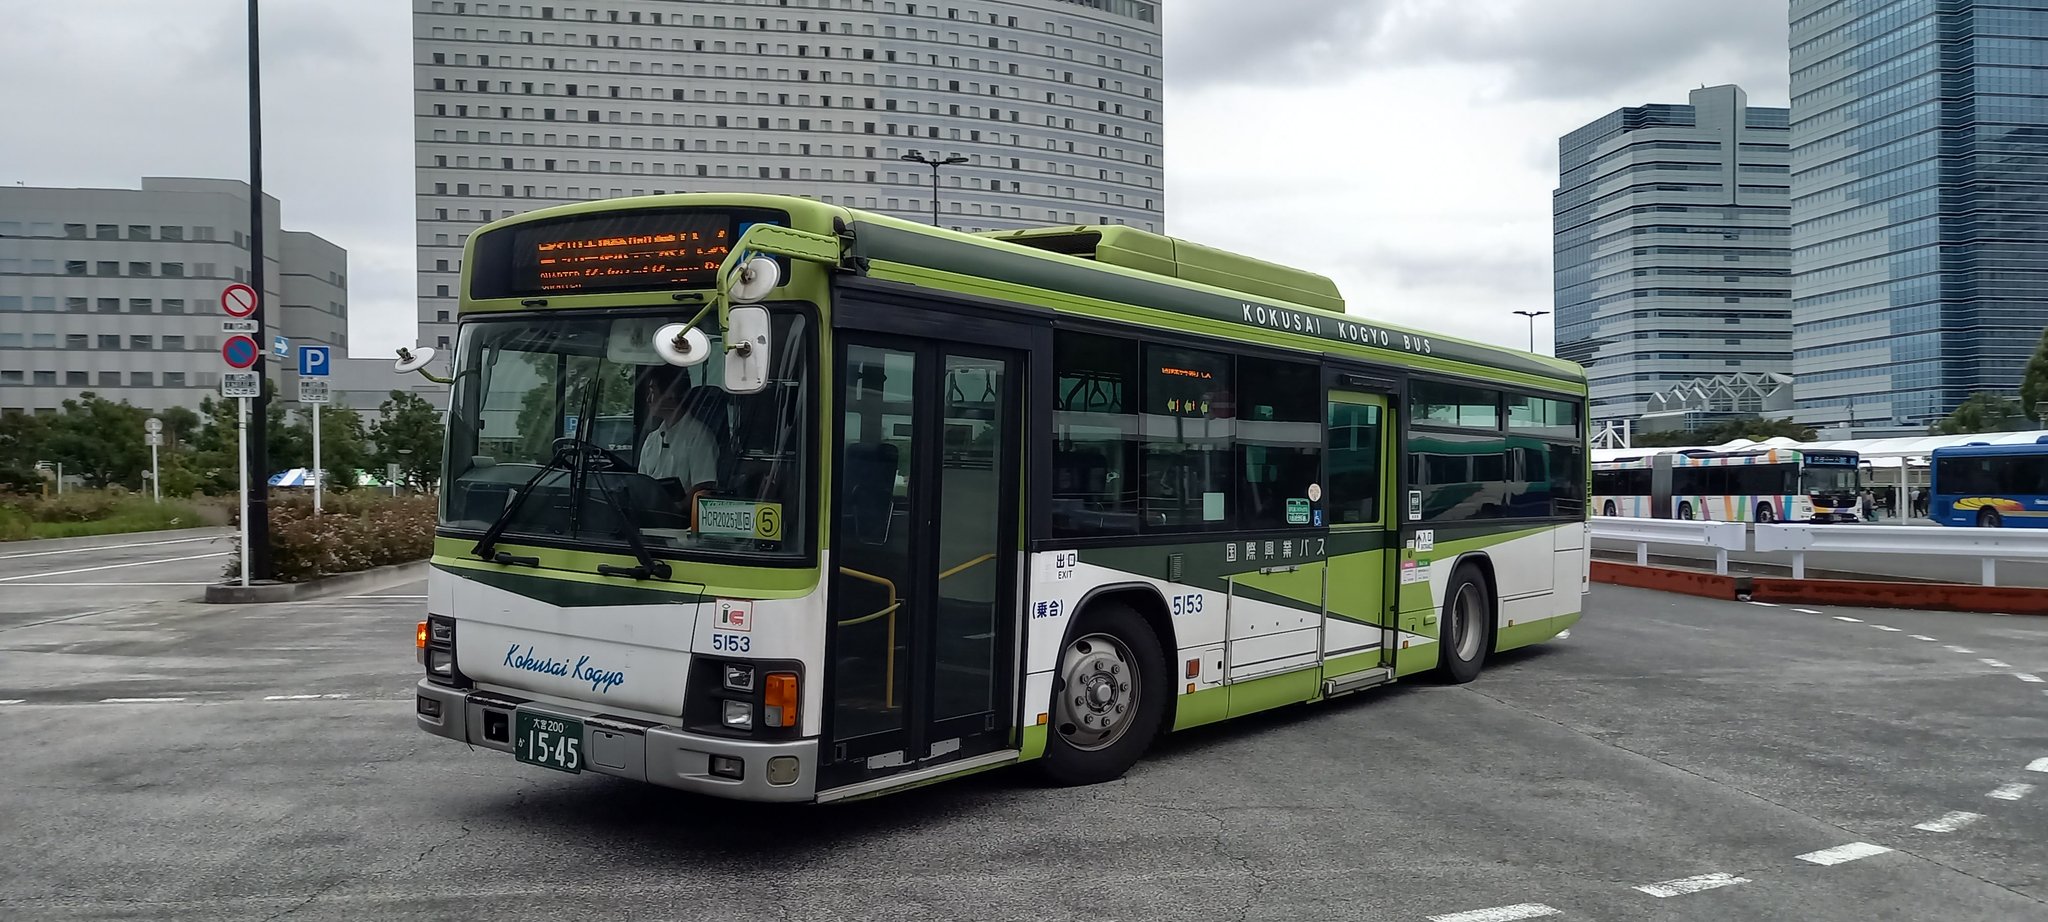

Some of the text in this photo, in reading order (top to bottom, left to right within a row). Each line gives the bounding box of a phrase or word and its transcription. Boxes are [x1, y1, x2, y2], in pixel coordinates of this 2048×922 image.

[1242, 303, 1431, 354] KOKUSAI KOGYO BUS
[306, 349, 325, 373] P
[701, 510, 755, 531] HCR2025巡回
[1226, 538, 1325, 562] 国際興業バス
[1056, 553, 1076, 569] 出口
[1058, 570, 1073, 580] EXIT
[1032, 599, 1064, 619] (乗合)
[1173, 594, 1203, 616] 5153
[713, 633, 751, 652] 5153
[503, 644, 624, 694] Kokusai Kogyo
[533, 718, 564, 733] 大宮200
[529, 729, 579, 769] 15-45
